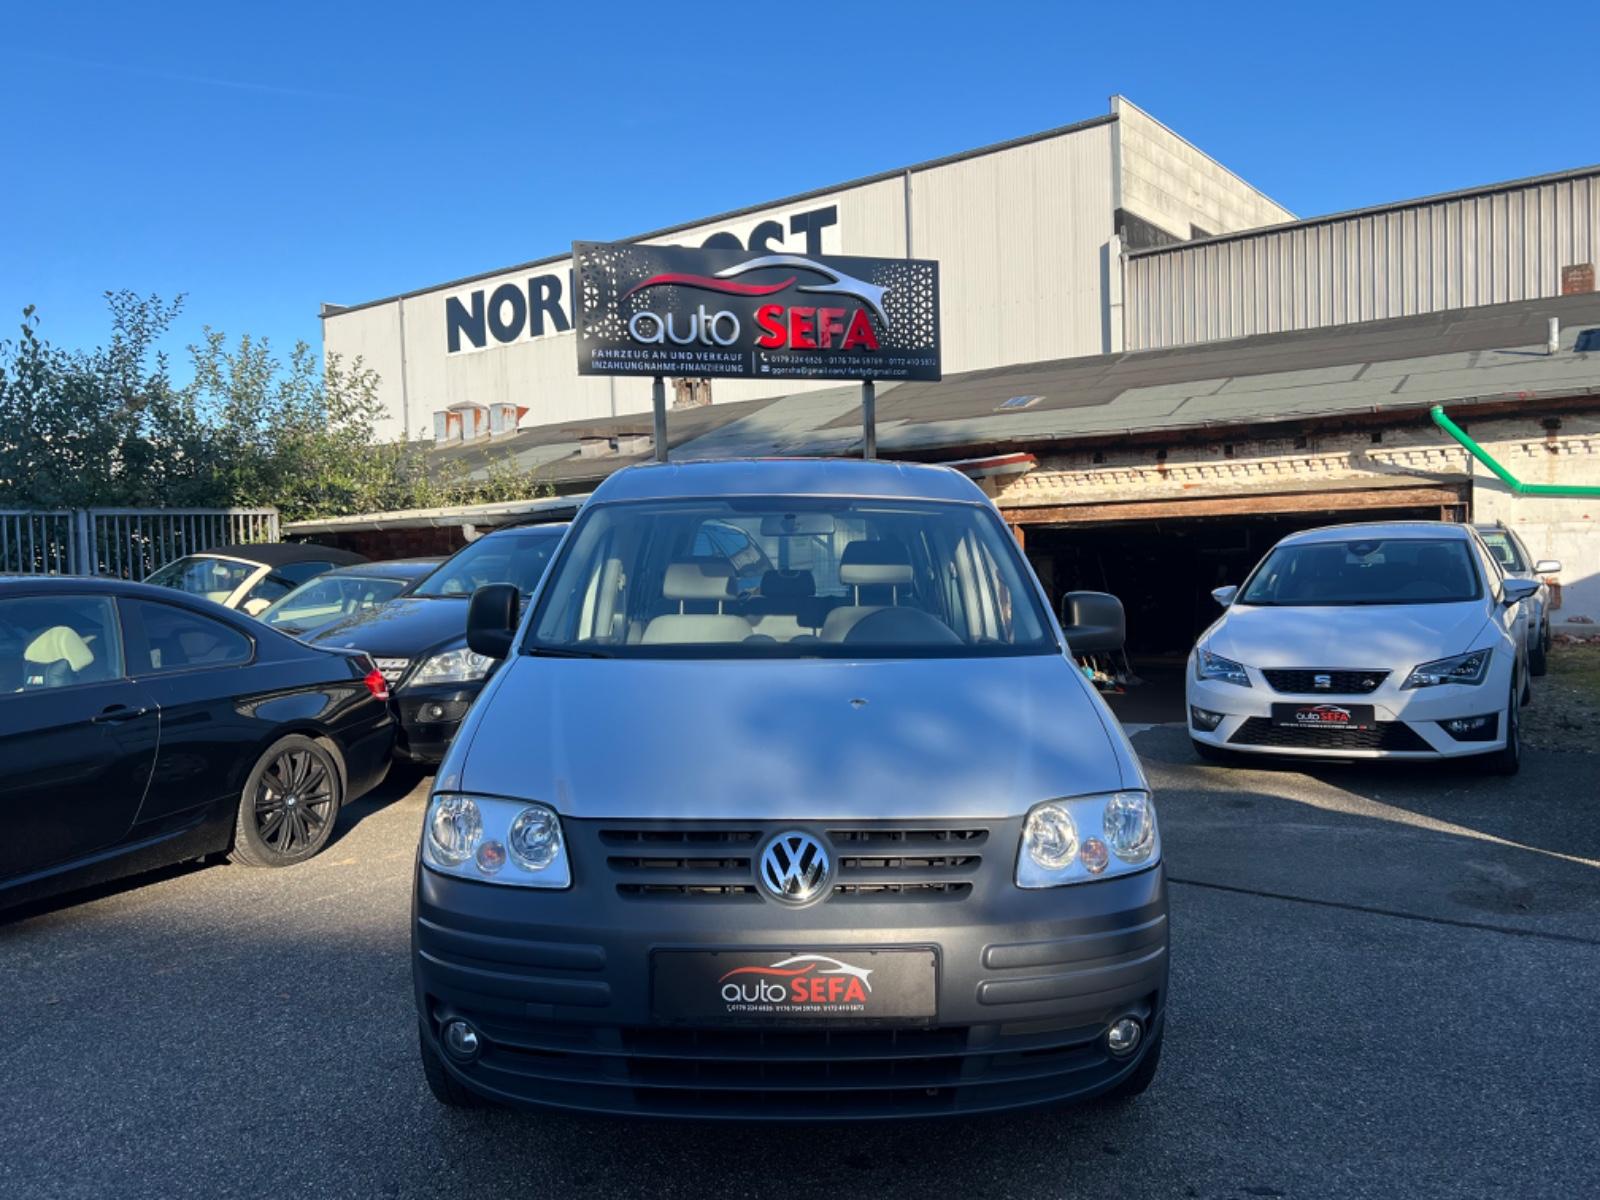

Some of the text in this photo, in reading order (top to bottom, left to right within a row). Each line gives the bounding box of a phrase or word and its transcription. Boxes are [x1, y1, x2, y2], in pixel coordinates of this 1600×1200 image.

[628, 304, 880, 350] auto SEFA
[591, 349, 744, 361] FAHRZEUG AN UND VERKAUF
[721, 976, 867, 1003] auto SEFA
